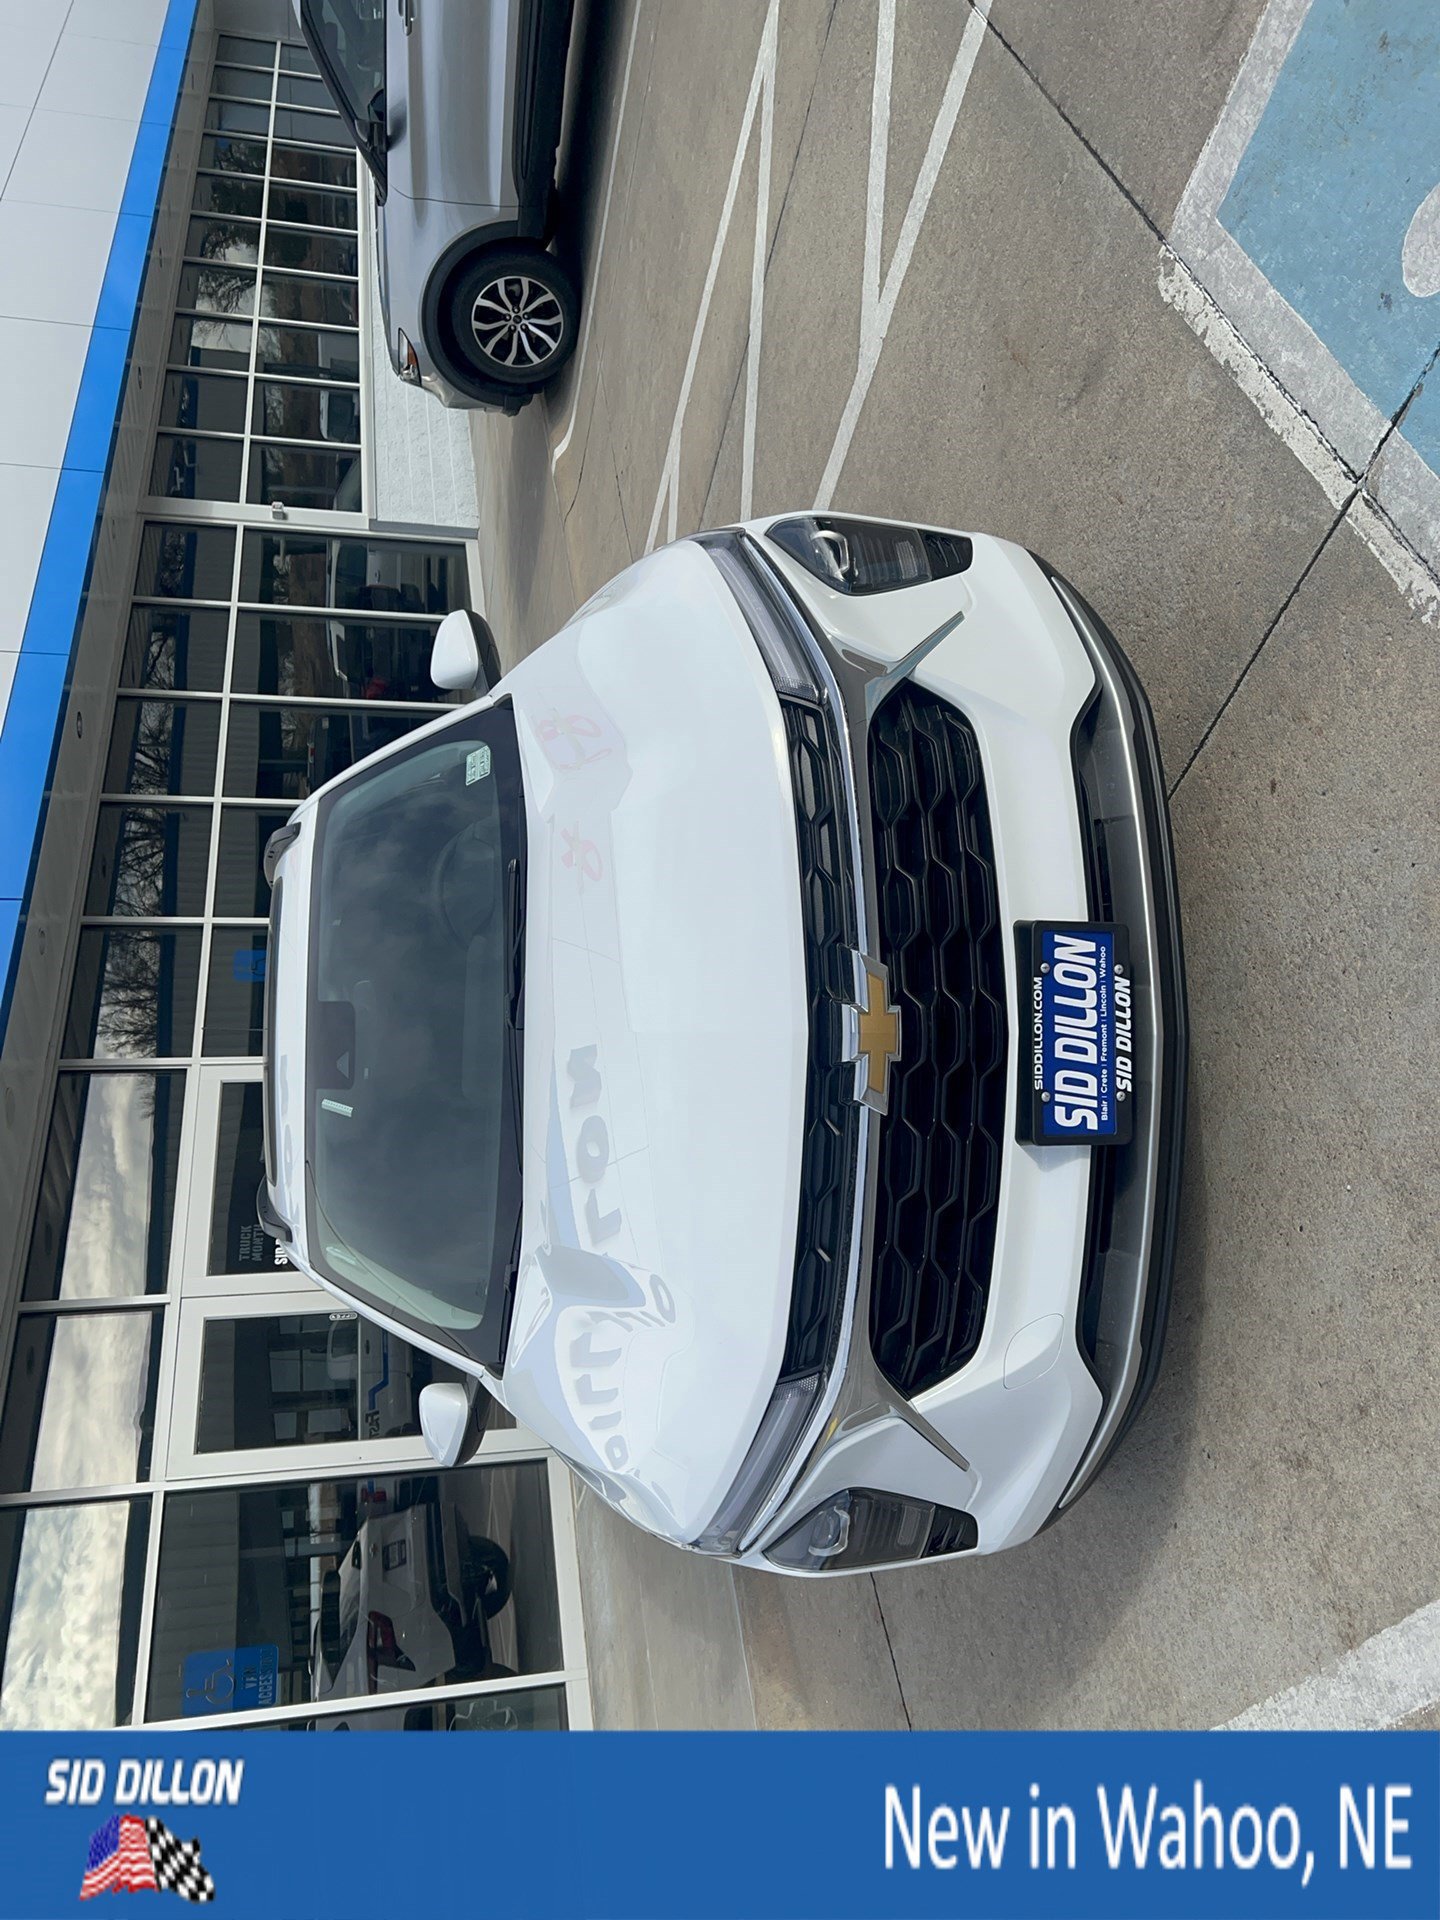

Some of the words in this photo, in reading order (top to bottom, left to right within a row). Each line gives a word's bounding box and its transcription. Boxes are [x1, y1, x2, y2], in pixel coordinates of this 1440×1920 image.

[1099, 946, 1107, 978] Wahoo
[1053, 934, 1098, 1065] DILLON
[1115, 977, 1132, 1052] DILLON
[1033, 976, 1044, 1091] SIDDILLON.COM
[1100, 1024, 1108, 1062] Fremont
[1100, 1068, 1108, 1094] Crete
[1116, 1057, 1132, 1092] SID
[1054, 1069, 1098, 1130] SID
[239, 1225, 252, 1261] TRUCK
[251, 1224, 264, 1261] MONTH
[274, 1247, 288, 1265] SID
[258, 1648, 274, 1705] ACCESS
